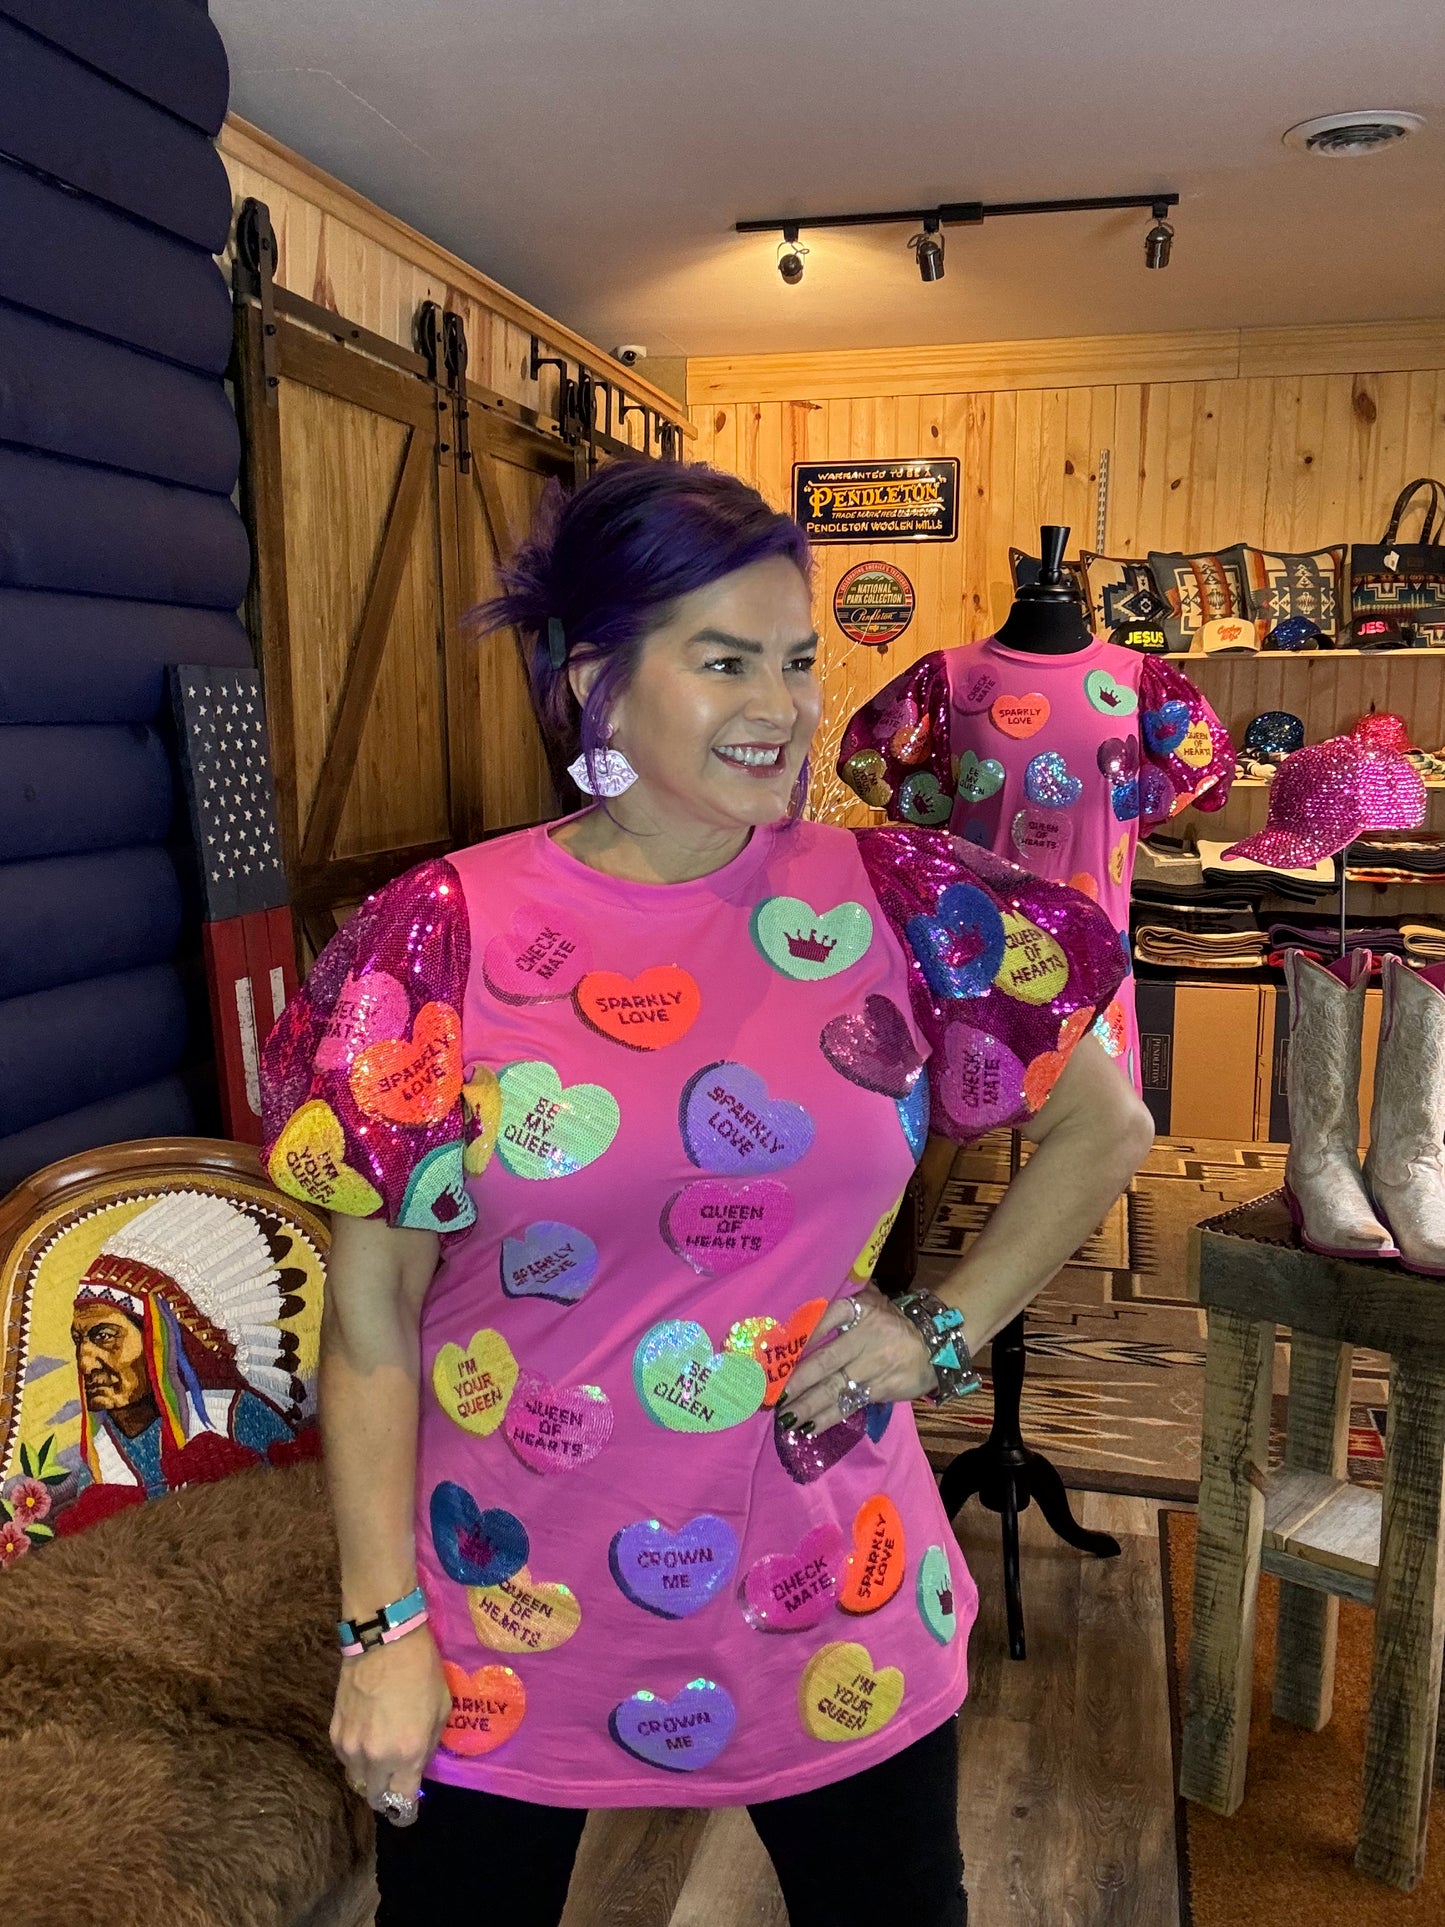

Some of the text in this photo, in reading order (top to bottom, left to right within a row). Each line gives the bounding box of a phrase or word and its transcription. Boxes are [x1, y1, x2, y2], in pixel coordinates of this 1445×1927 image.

[818, 466, 931, 480] WARRANTED TO BE A
[807, 519, 942, 533] PENDLETON WOOLEN MILLS
[832, 511, 856, 519] TRADE
[857, 510, 880, 518] MARK
[846, 594, 902, 604] PARK COLLECTION
[857, 583, 892, 593] NATIONAL
[851, 608, 898, 623] Pendleton
[1125, 631, 1164, 645] JESUS
[967, 674, 990, 701] CHECK
[976, 679, 996, 703] MATE
[999, 708, 1042, 717] SPARKLY
[1008, 717, 1032, 725] LOVE
[1028, 821, 1059, 833] QUEEN
[1035, 830, 1048, 838] OF
[516, 926, 562, 972] CHECK
[1004, 928, 1042, 950] QUEEN
[537, 939, 577, 980] MATE
[1024, 944, 1042, 961] OF
[1010, 956, 1065, 987] HEARTS
[596, 991, 682, 1012] SPARKLY
[617, 1008, 669, 1025] LOVE
[378, 1032, 450, 1093] SPARKLY
[1152, 1038, 1161, 1083] PENDLETON
[402, 1064, 448, 1101] LOVE
[962, 1050, 984, 1107] CHECK
[983, 1059, 1000, 1105] MATE
[523, 1112, 555, 1138] MY
[707, 1085, 785, 1154] SPARKLY
[708, 1112, 755, 1157] LOVE
[286, 1150, 331, 1205] QUEEN
[299, 1145, 335, 1197] YOUR
[700, 1204, 765, 1220] QUEEN
[716, 1219, 743, 1234] OF
[686, 1234, 763, 1251] HEARTS
[536, 1260, 577, 1283] LOVE
[457, 1357, 478, 1377] I'M
[688, 1359, 712, 1384] BE
[454, 1372, 494, 1399] YOUR
[674, 1372, 705, 1398] MY
[457, 1388, 503, 1419] QUEEN
[525, 1400, 584, 1428] QUEEN
[653, 1382, 715, 1423] QUEEN
[539, 1420, 562, 1437] OF
[513, 1427, 584, 1457] HEARTS
[637, 1547, 714, 1569] CROWN
[857, 1513, 887, 1598] SPARKLY
[874, 1537, 895, 1587] LOVE
[662, 1574, 691, 1589] ME
[772, 1555, 828, 1601] CHECK
[499, 1578, 554, 1618] QUEEN
[784, 1572, 833, 1613] MATE
[478, 1596, 542, 1648] HEARTS
[509, 1600, 533, 1621] OF
[851, 1673, 877, 1696] I'M
[451, 1696, 508, 1715] ARKLY
[834, 1683, 873, 1716] YOUR
[637, 1711, 712, 1736] CROWN
[817, 1697, 867, 1731] QUEEN
[665, 1735, 693, 1750] ME
